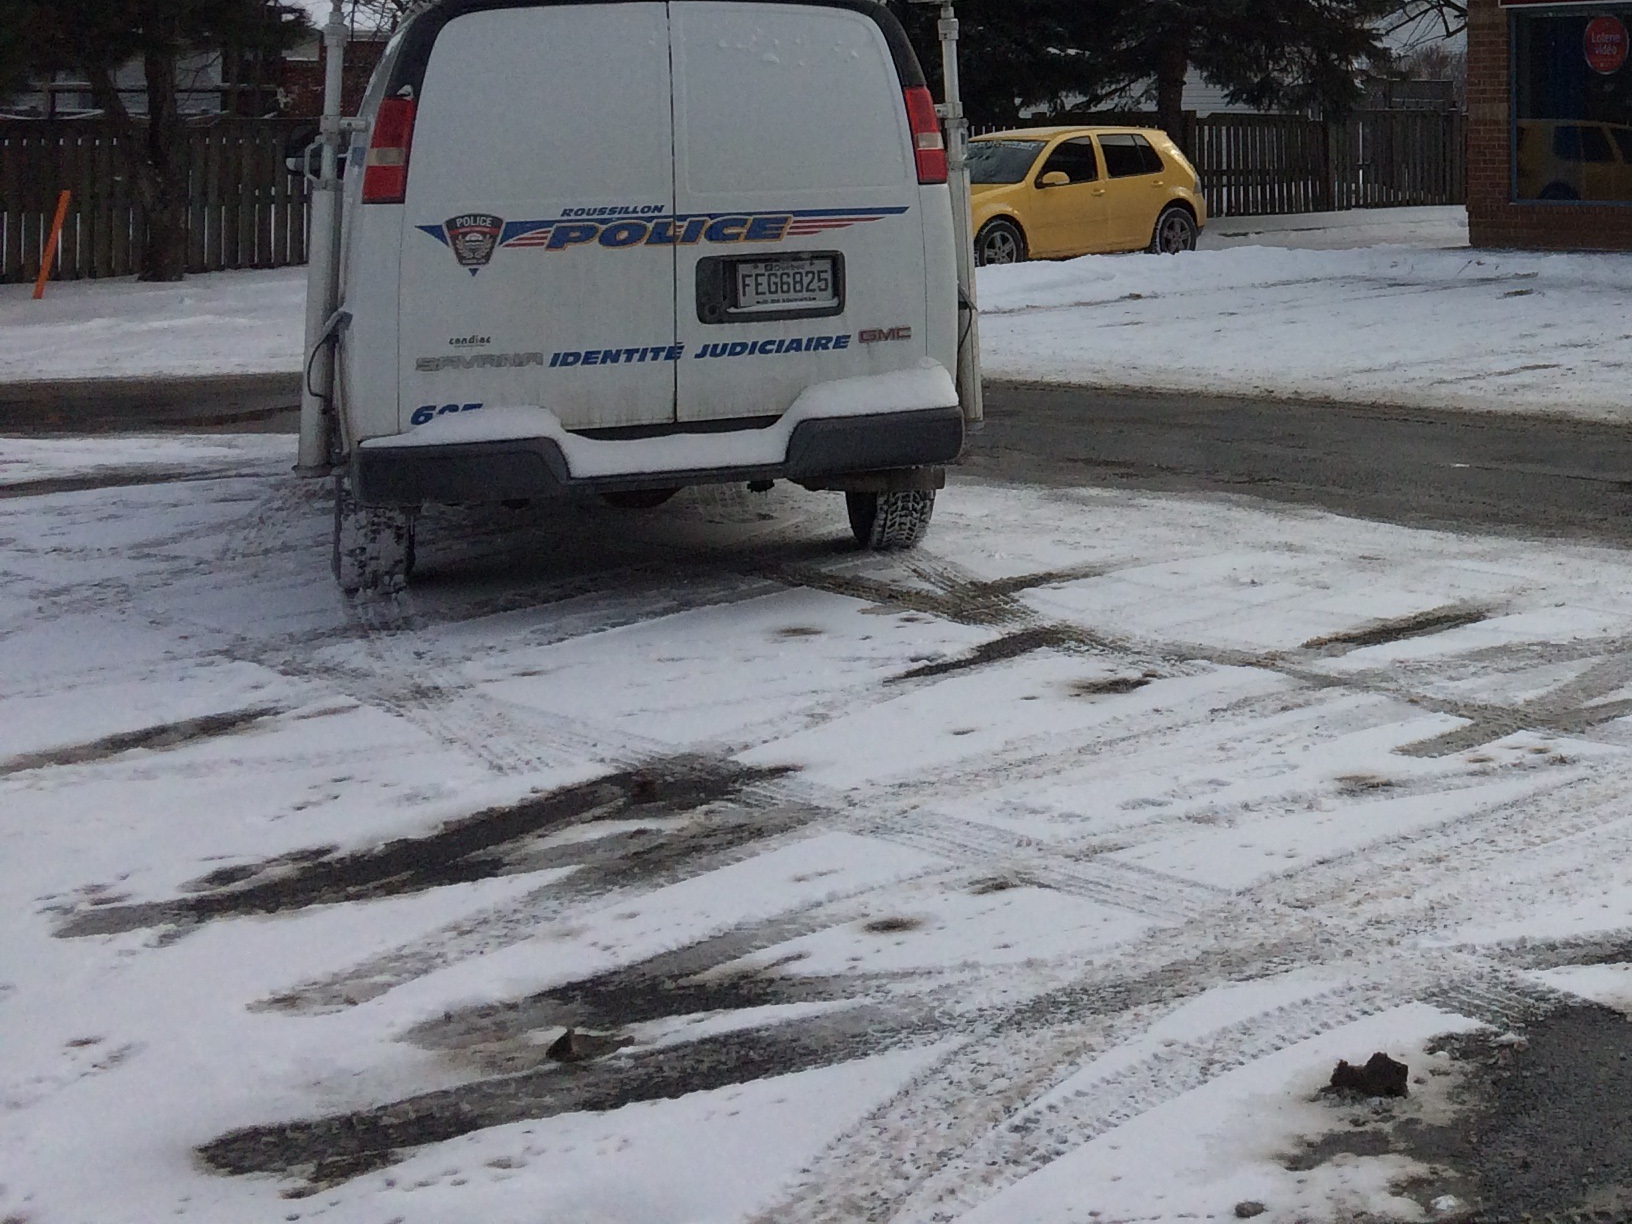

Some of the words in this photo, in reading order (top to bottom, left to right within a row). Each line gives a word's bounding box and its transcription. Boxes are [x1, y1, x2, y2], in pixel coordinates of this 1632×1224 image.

[456, 216, 493, 227] POLICE
[560, 204, 664, 218] ROUSSILLON
[544, 214, 791, 251] POLICE
[741, 269, 829, 297] FEG6825
[858, 326, 912, 343] GMC
[548, 341, 685, 368] IDENTITÉ
[693, 334, 852, 360] JUDICIAIRE
